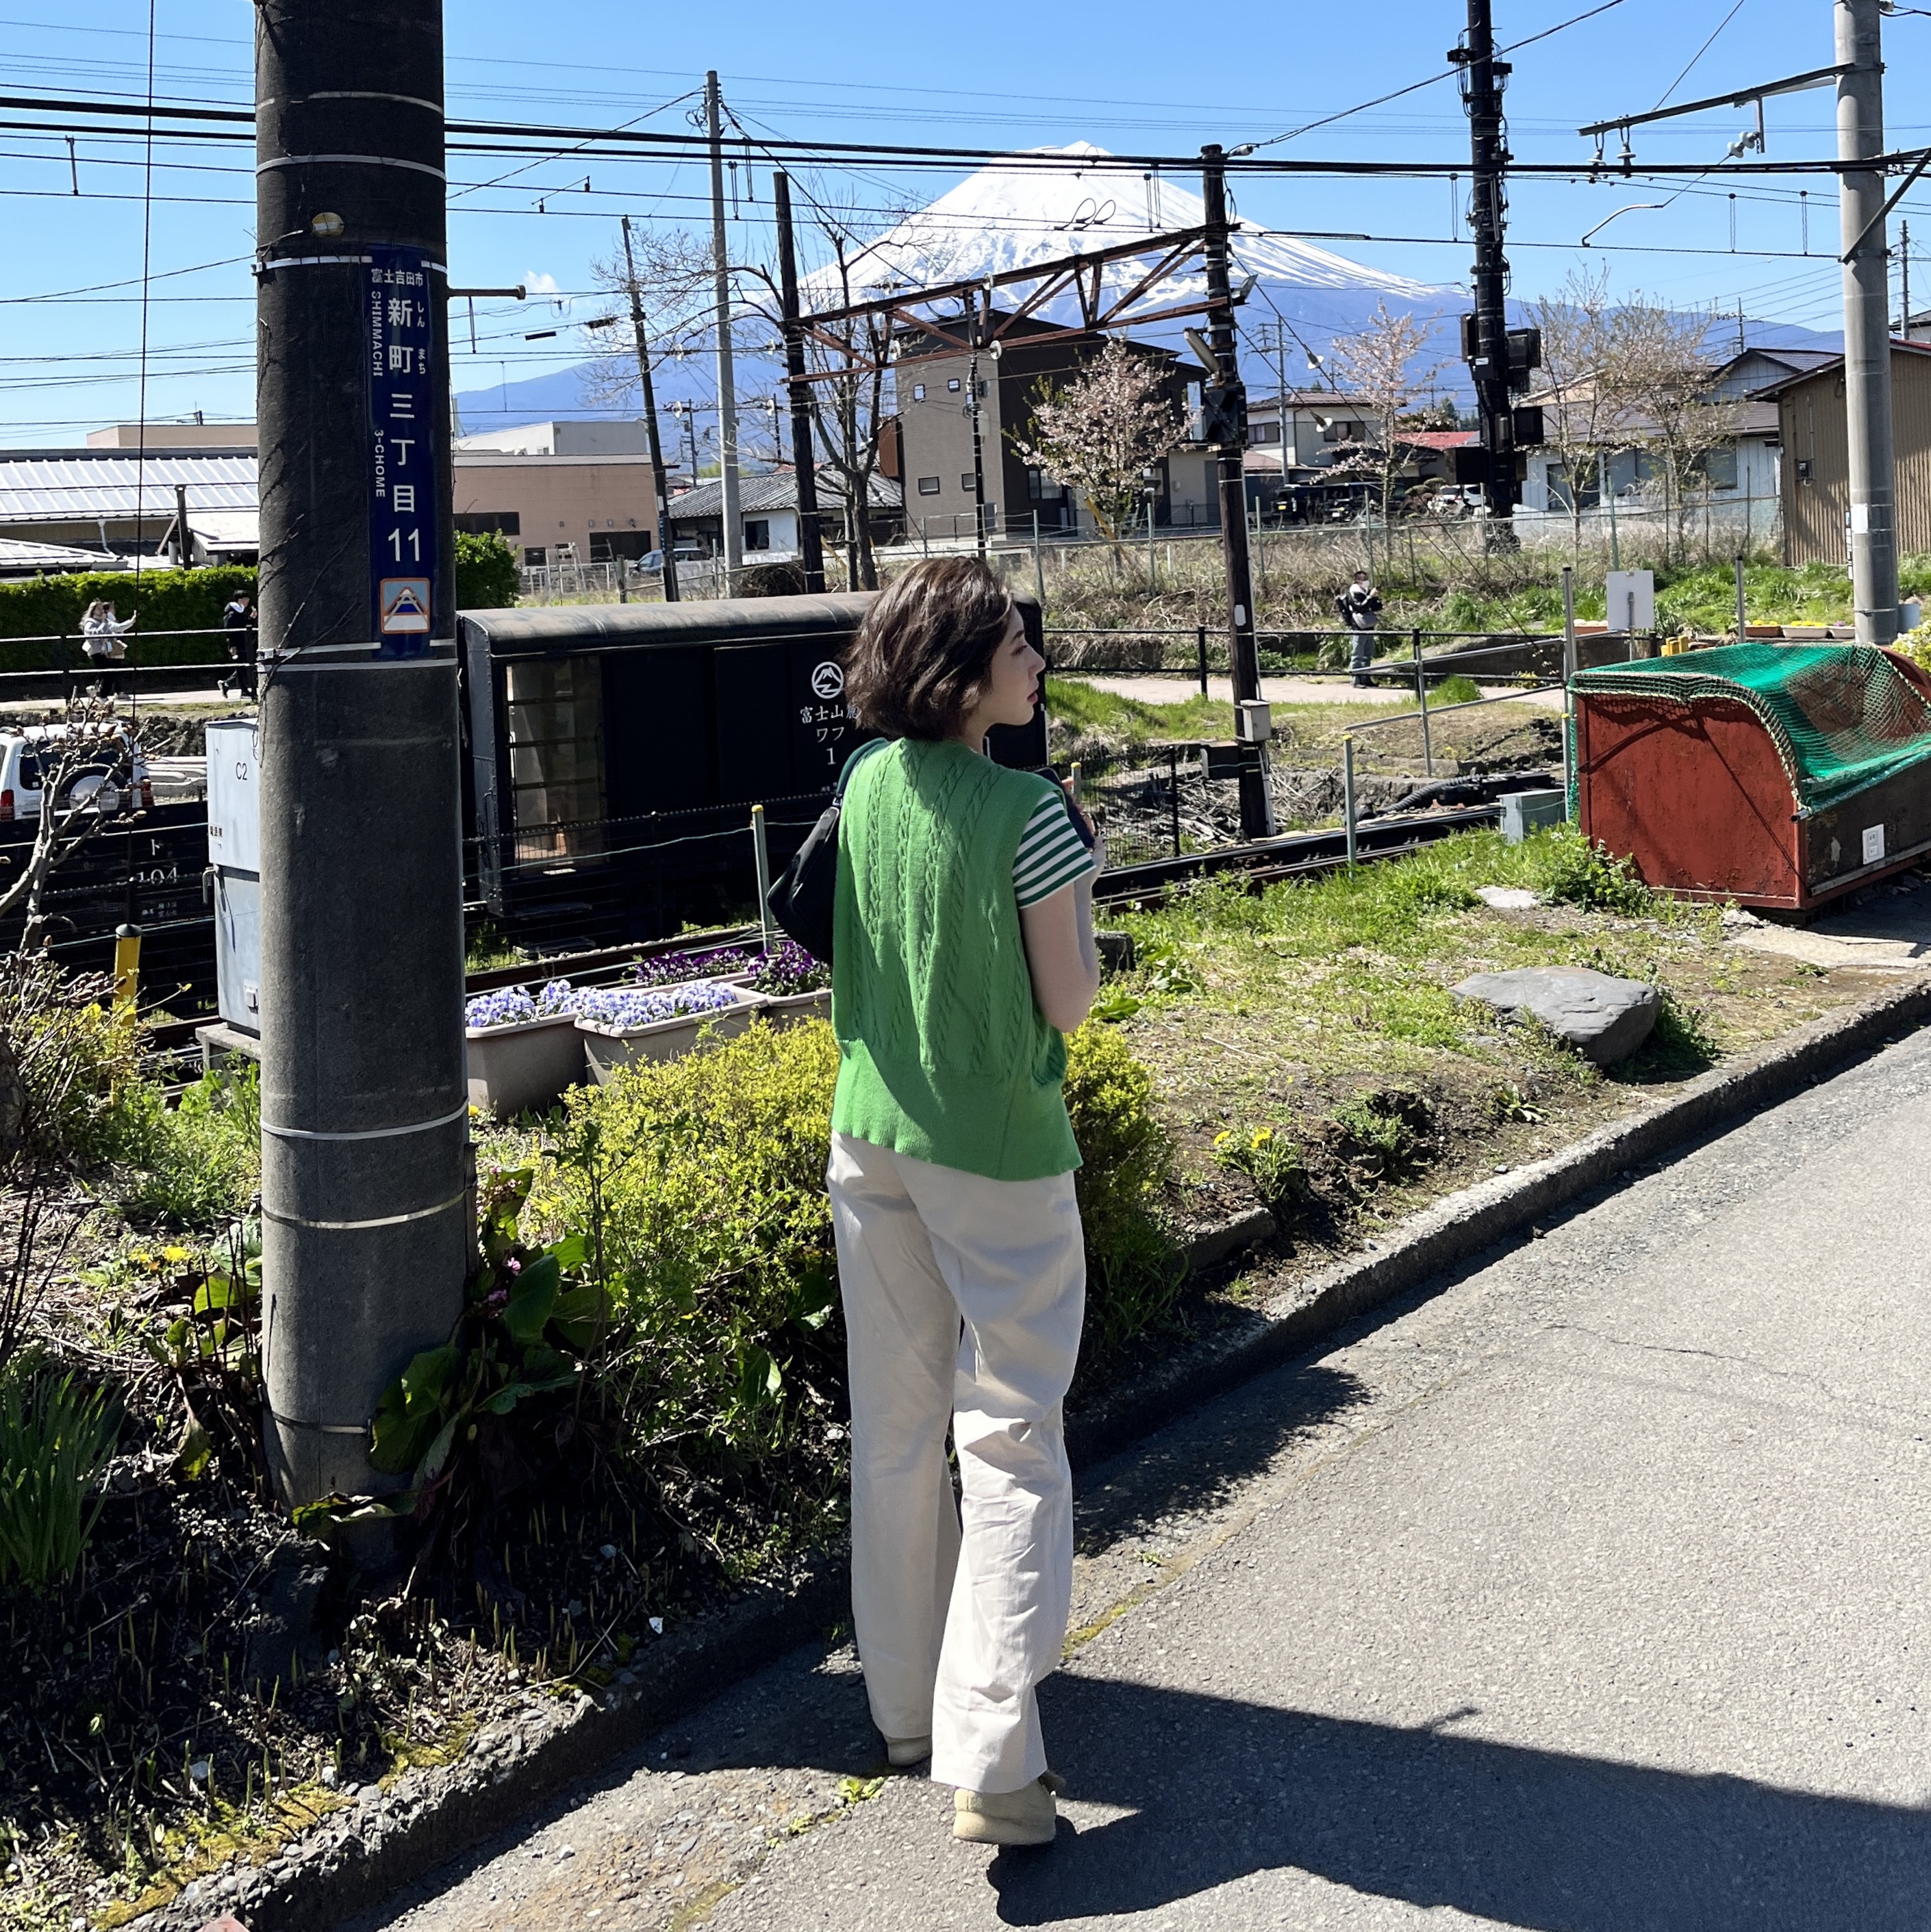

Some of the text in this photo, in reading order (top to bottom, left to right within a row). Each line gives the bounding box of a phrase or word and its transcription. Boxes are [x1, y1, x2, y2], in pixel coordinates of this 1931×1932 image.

[371, 268, 424, 287] 富士吉田市
[371, 290, 386, 498] SHIMMACHI 3-CHOME
[816, 726, 845, 743] ワフ
[826, 747, 837, 765] 1
[236, 761, 248, 781] C2
[136, 866, 178, 885] 104
